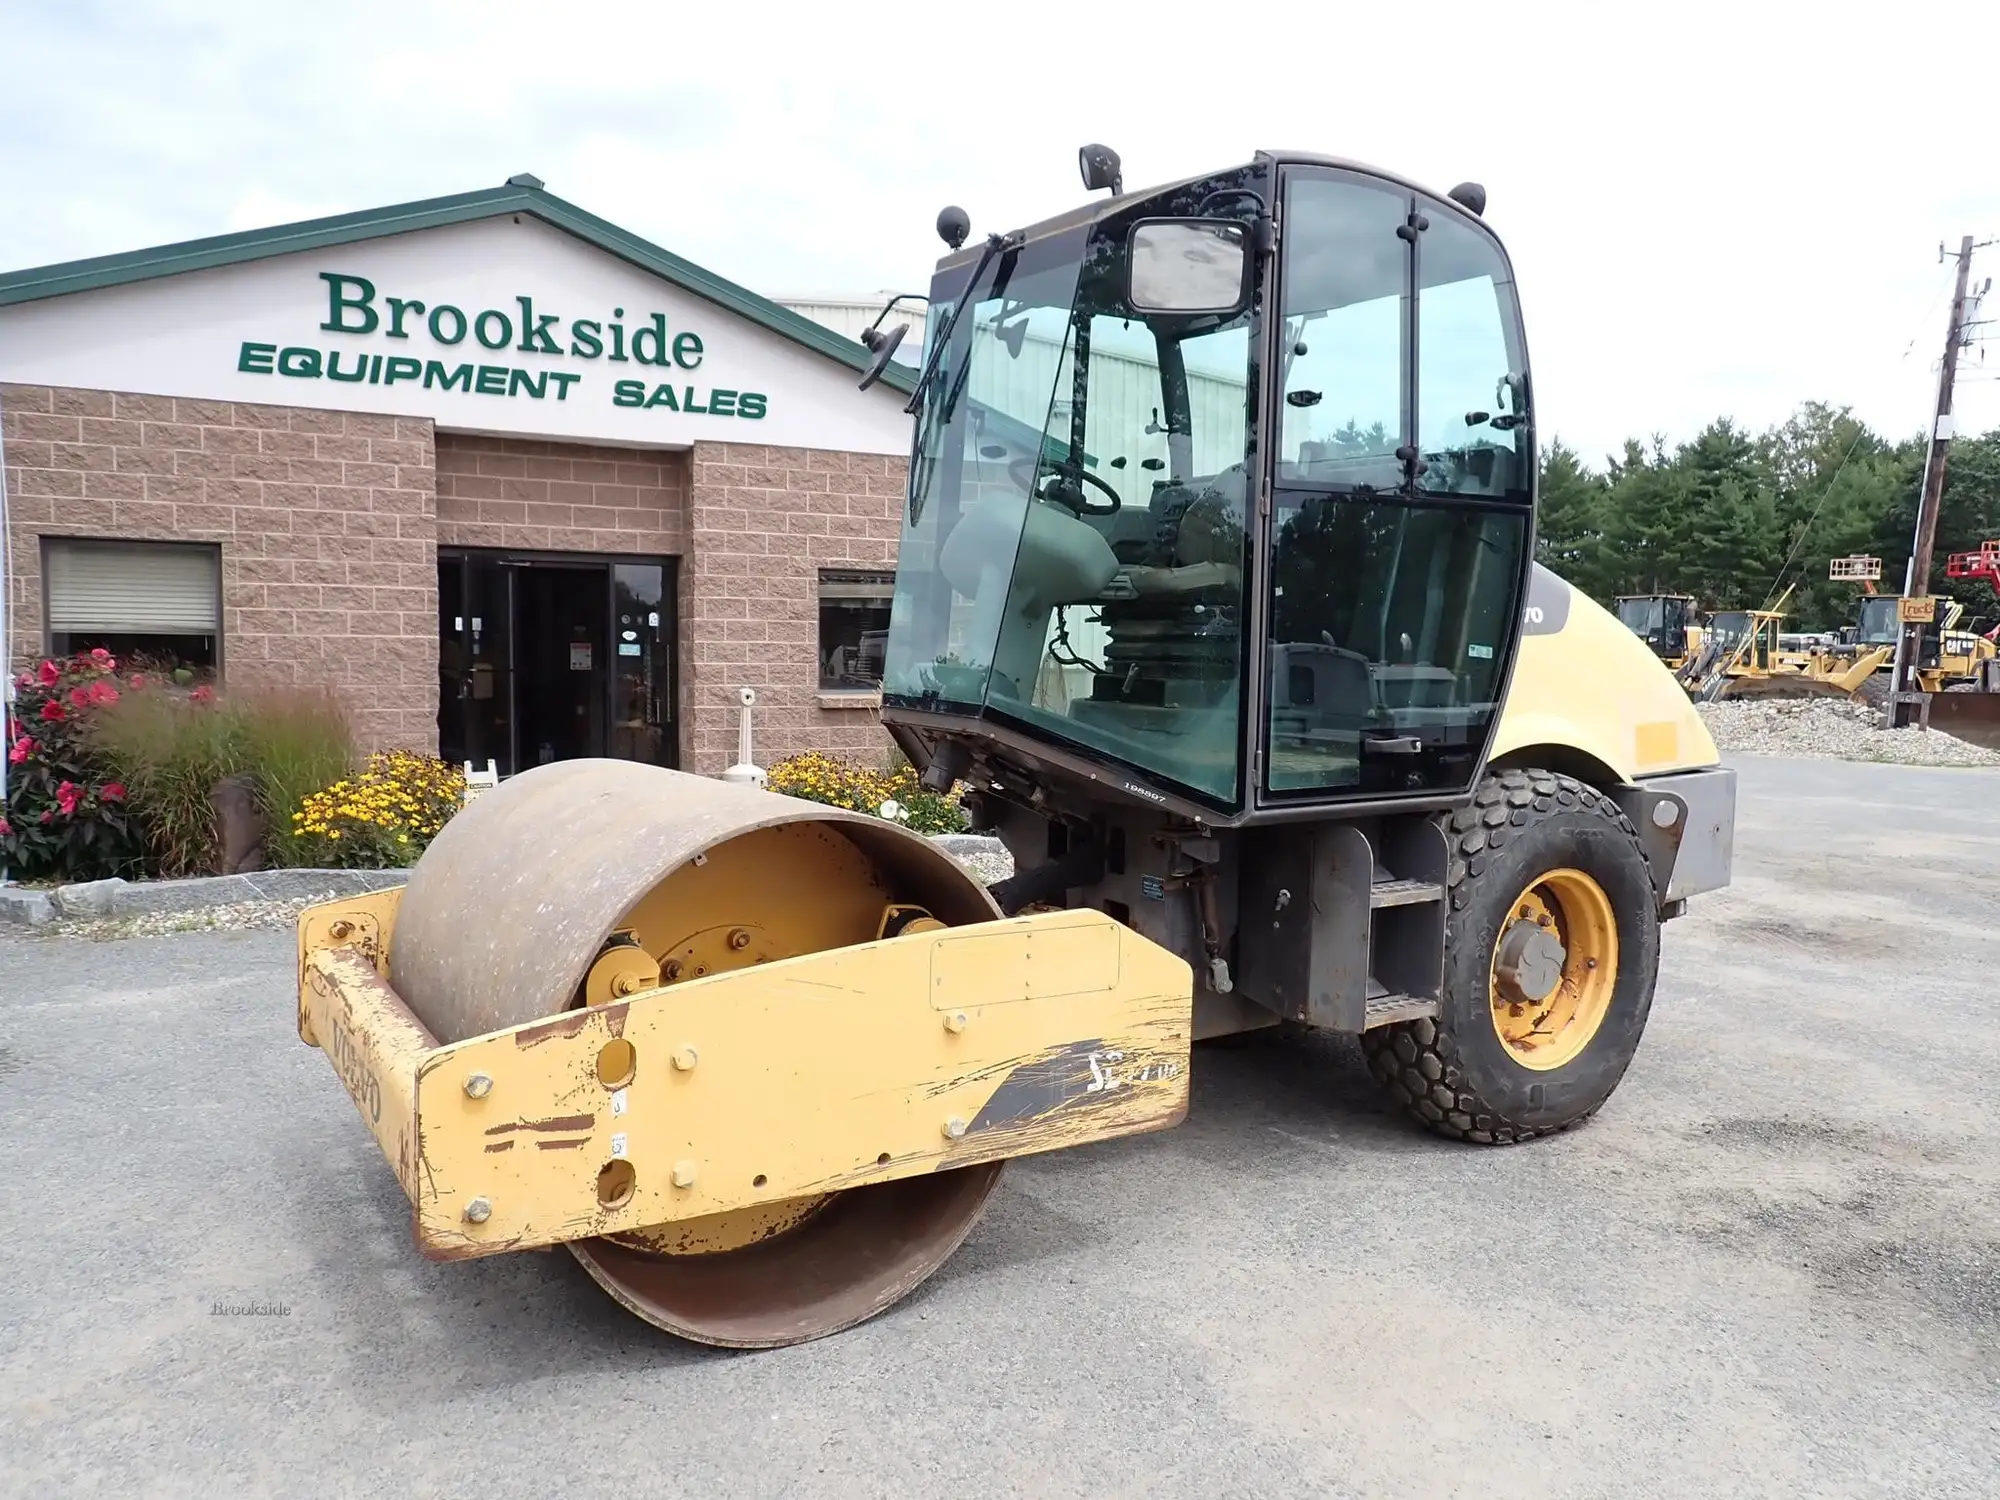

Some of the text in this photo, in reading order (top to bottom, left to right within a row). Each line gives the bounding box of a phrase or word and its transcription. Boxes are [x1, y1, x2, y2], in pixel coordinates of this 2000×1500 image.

[318, 272, 704, 371] Brookside
[238, 341, 768, 420] EQUIPMENT SALES
[1124, 782, 1166, 802] 198897
